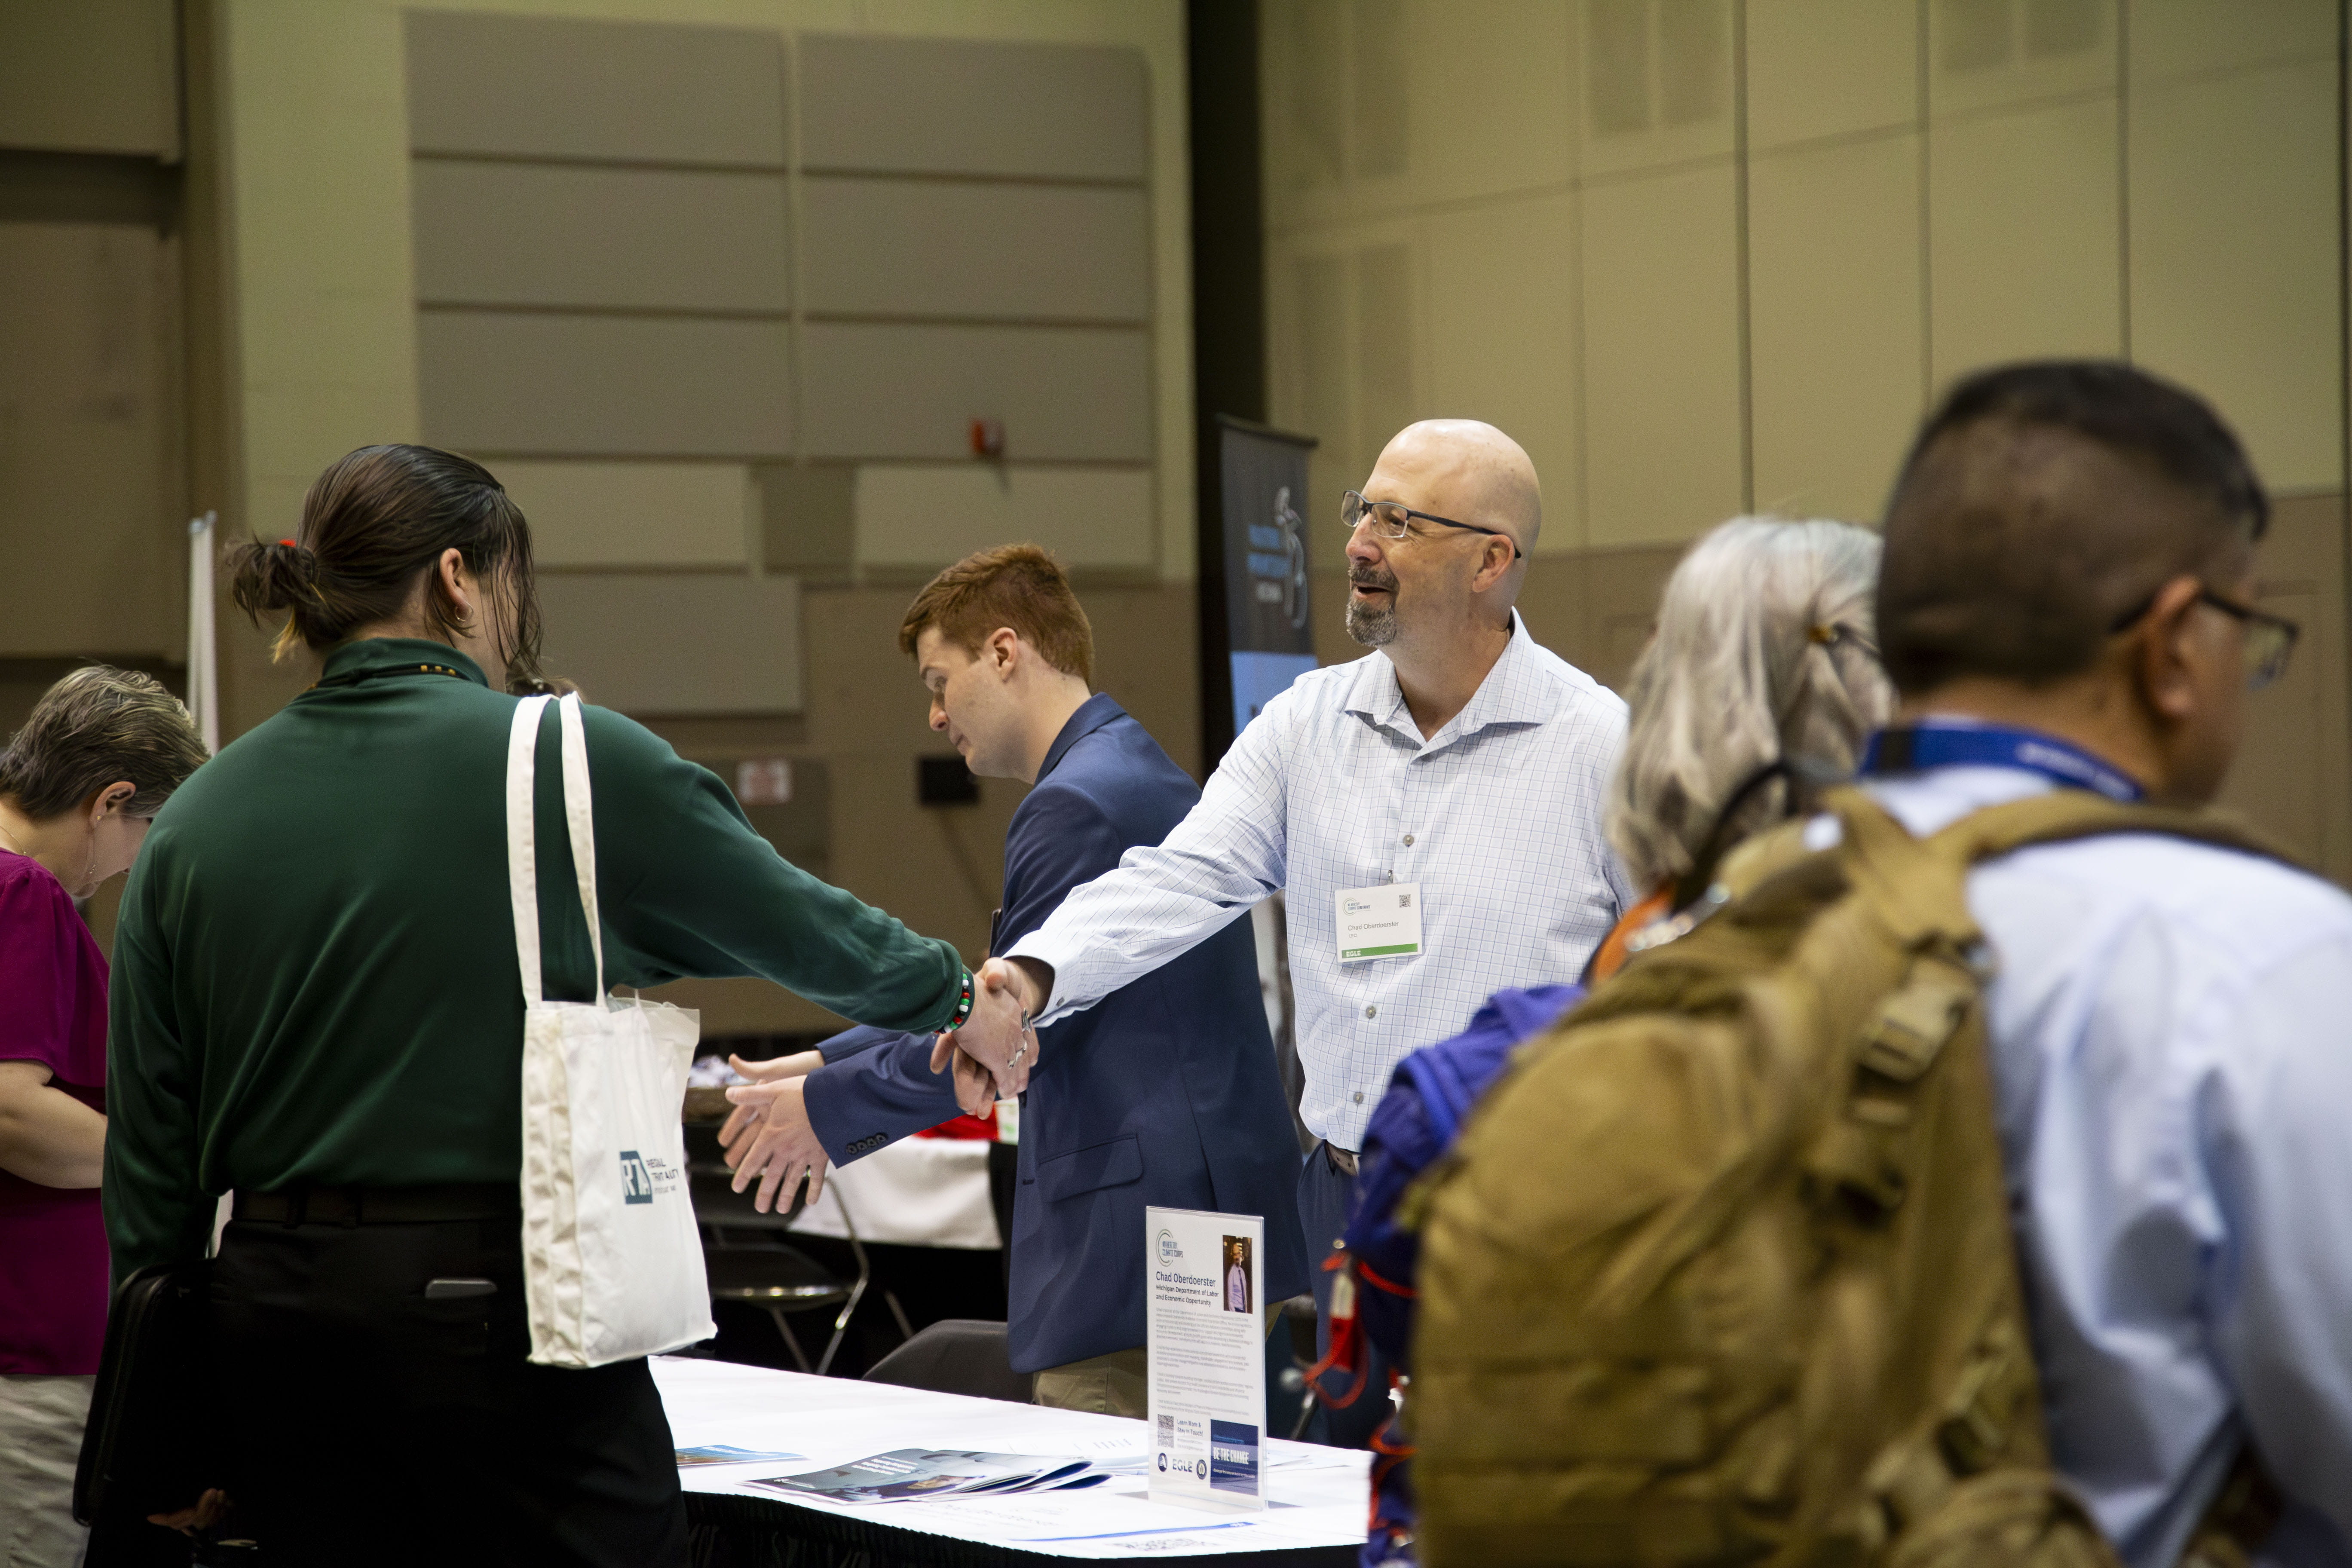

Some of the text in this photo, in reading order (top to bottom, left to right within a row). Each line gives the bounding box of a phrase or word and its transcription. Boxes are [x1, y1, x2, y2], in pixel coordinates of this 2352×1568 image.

[1364, 921, 1399, 929] Oberdoerster
[1156, 1271, 1216, 1287] Chad Oberdoerster
[1176, 1286, 1200, 1295] Department
[1186, 1297, 1211, 1307] Opportunity
[1213, 1447, 1220, 1460] BE
[1221, 1448, 1230, 1461] THE
[1231, 1449, 1249, 1465] CHANGE
[1173, 1458, 1193, 1473] EGLE
